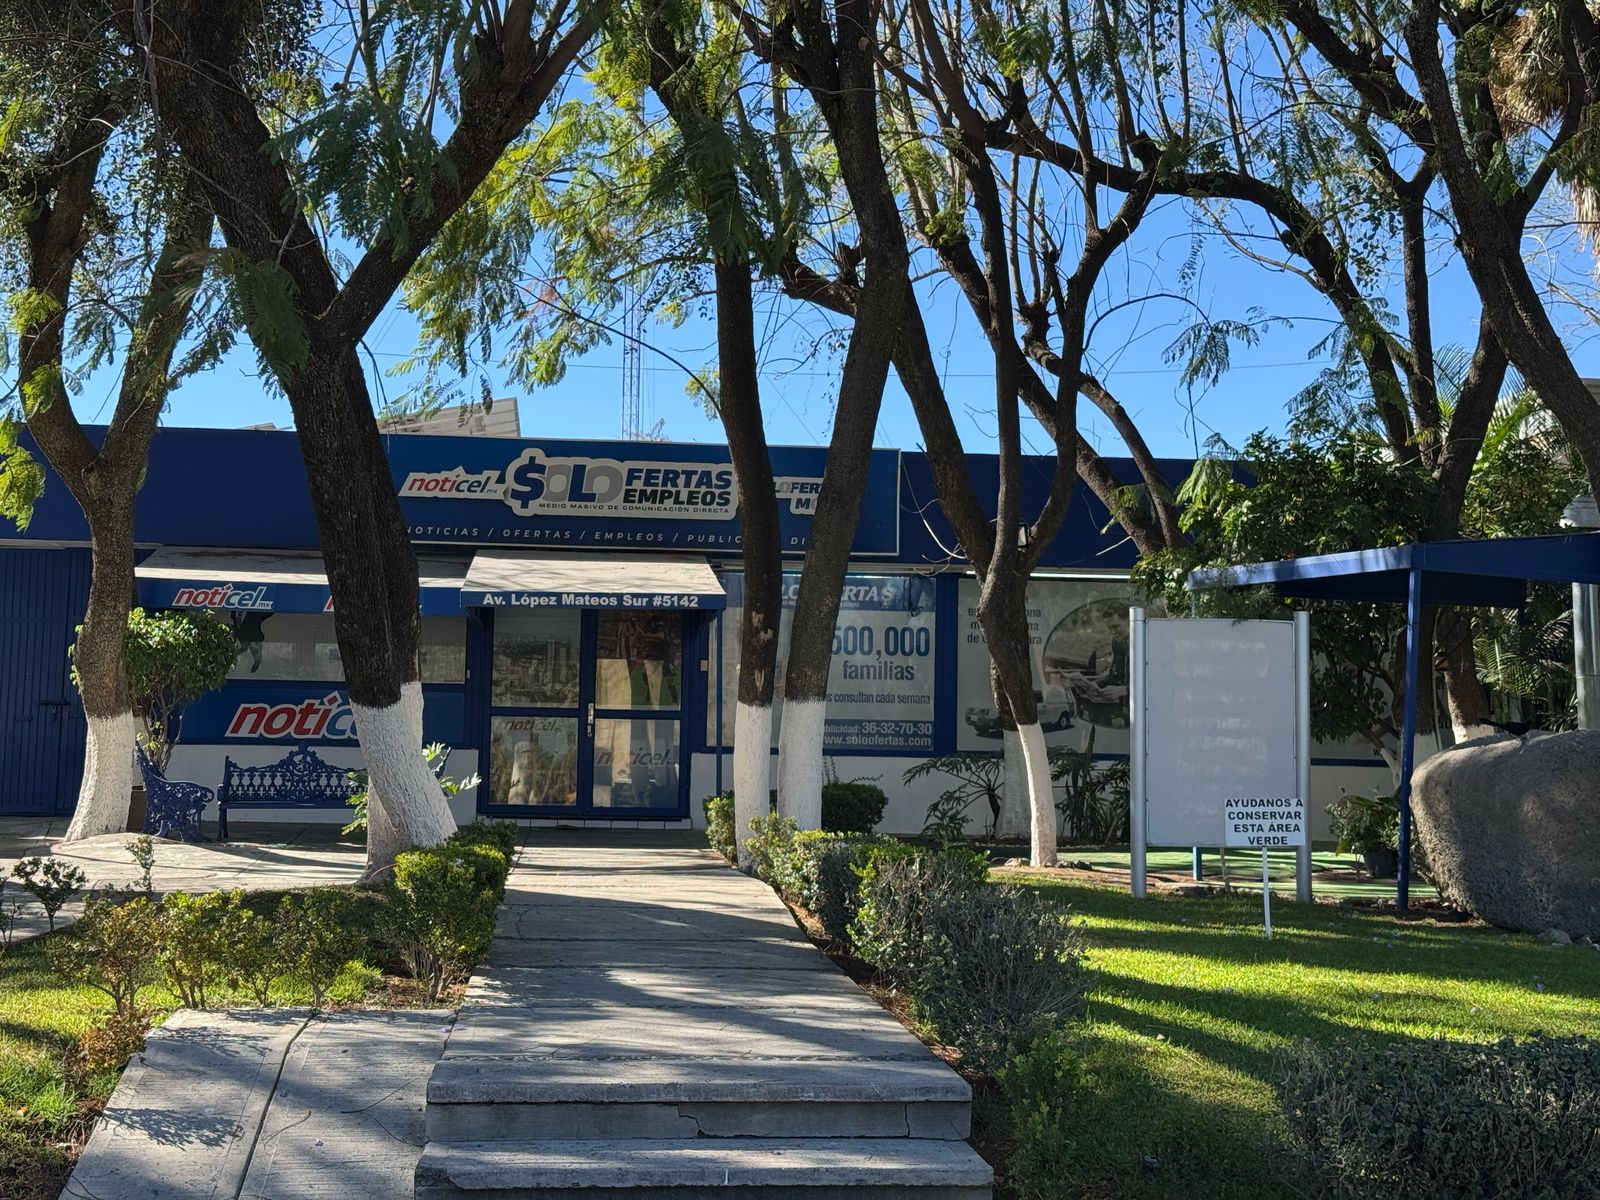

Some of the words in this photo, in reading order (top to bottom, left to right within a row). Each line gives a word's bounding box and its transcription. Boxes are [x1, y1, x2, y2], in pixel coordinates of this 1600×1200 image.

[625, 468, 733, 489] FERTAS
[622, 488, 731, 507] EMPLEOS
[622, 505, 689, 513] COMUNICACIÓN
[502, 529, 572, 539] OFERTAS
[594, 531, 665, 542] EMPLEOS
[687, 533, 742, 544] PUBLIC
[790, 537, 806, 545] DI
[482, 593, 506, 605] Av.
[511, 592, 557, 608] López
[561, 593, 618, 606] Mateos
[622, 595, 649, 606] Sur
[652, 595, 699, 608] #5142
[967, 633, 980, 643] de
[842, 660, 915, 681] familias
[835, 691, 874, 704] consultan
[875, 693, 896, 704] cada
[897, 696, 931, 705] semana
[226, 690, 358, 738] notic
[825, 724, 861, 735] blicidad:
[862, 722, 932, 735] 36-32-70-30
[824, 734, 932, 747] ww.soloofertas.com
[1225, 798, 1291, 808] AYUDANOS
[1295, 798, 1304, 807] A
[1227, 811, 1302, 820] CONSERVAR
[1234, 823, 1264, 833] ESTA
[1268, 820, 1300, 833] ÁREA
[1248, 836, 1288, 845] VERDE
